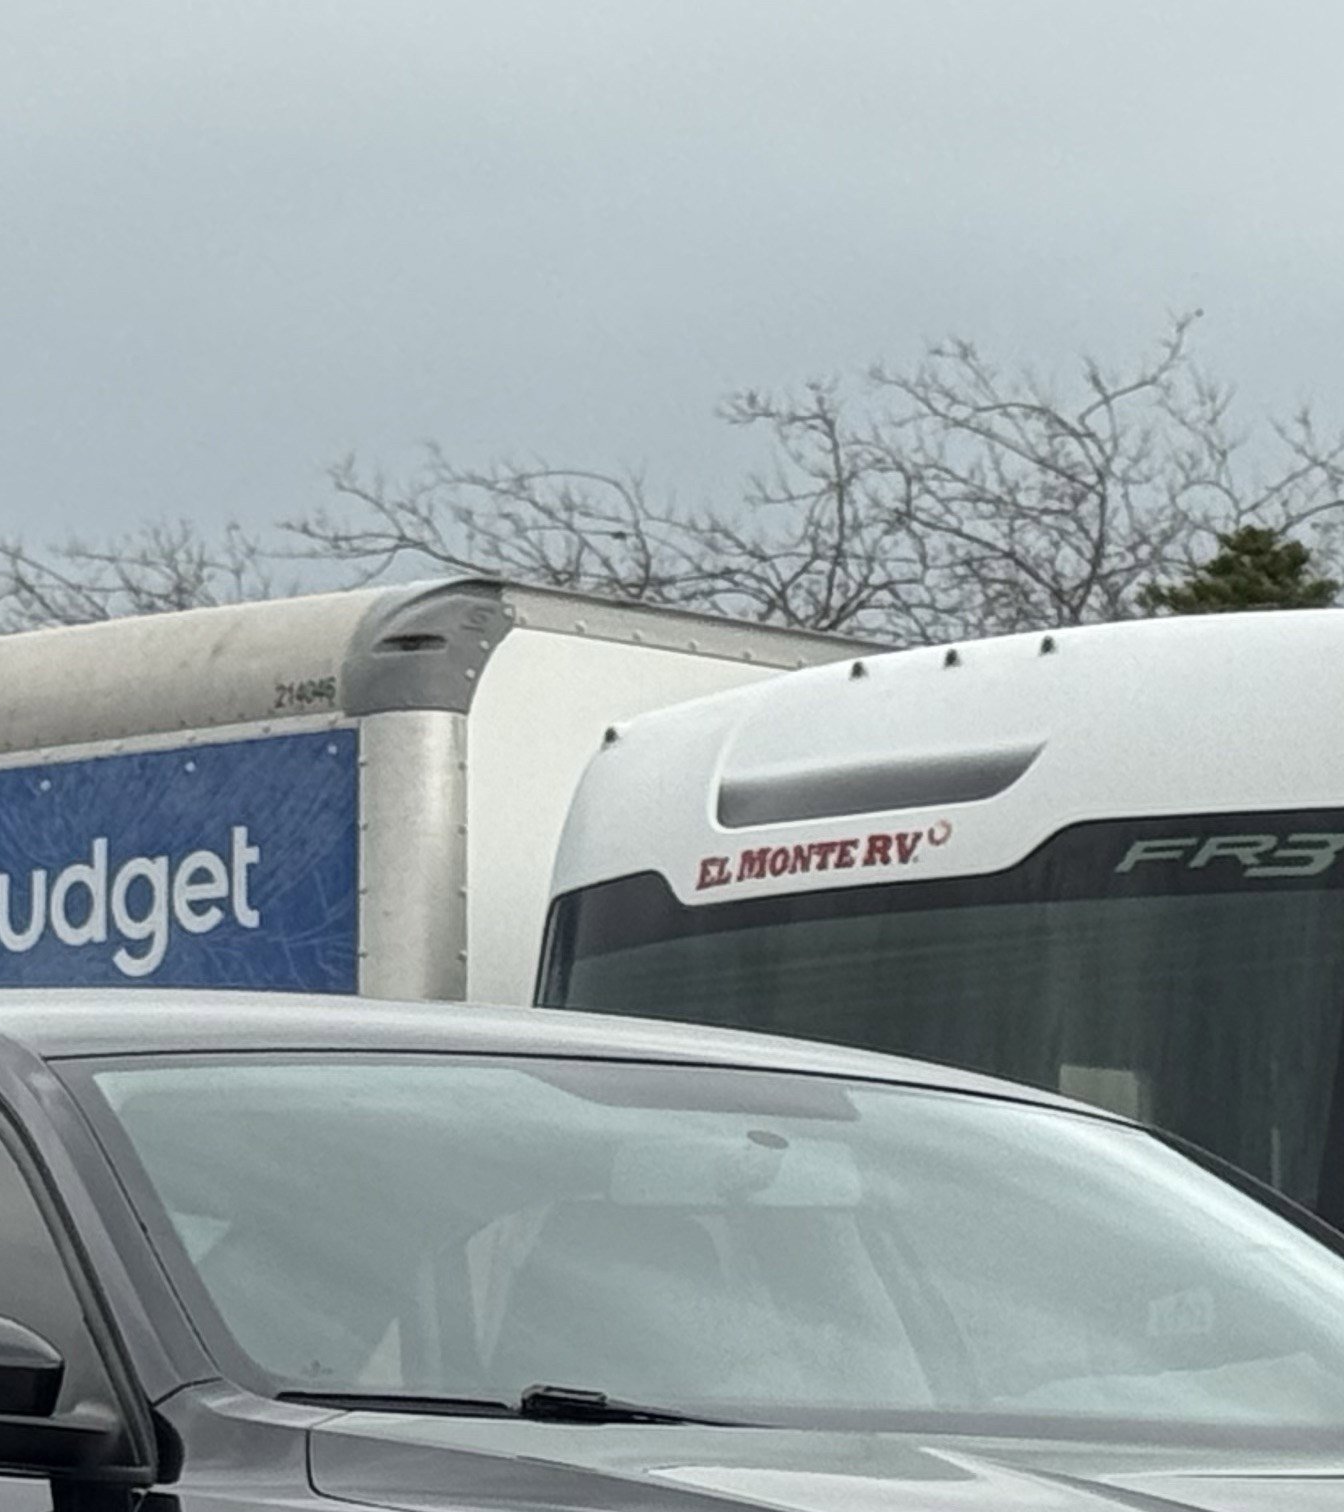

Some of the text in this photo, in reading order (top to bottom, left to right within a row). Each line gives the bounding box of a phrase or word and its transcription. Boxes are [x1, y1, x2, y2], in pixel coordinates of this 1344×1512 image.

[695, 831, 923, 891] EL MONTE RV
